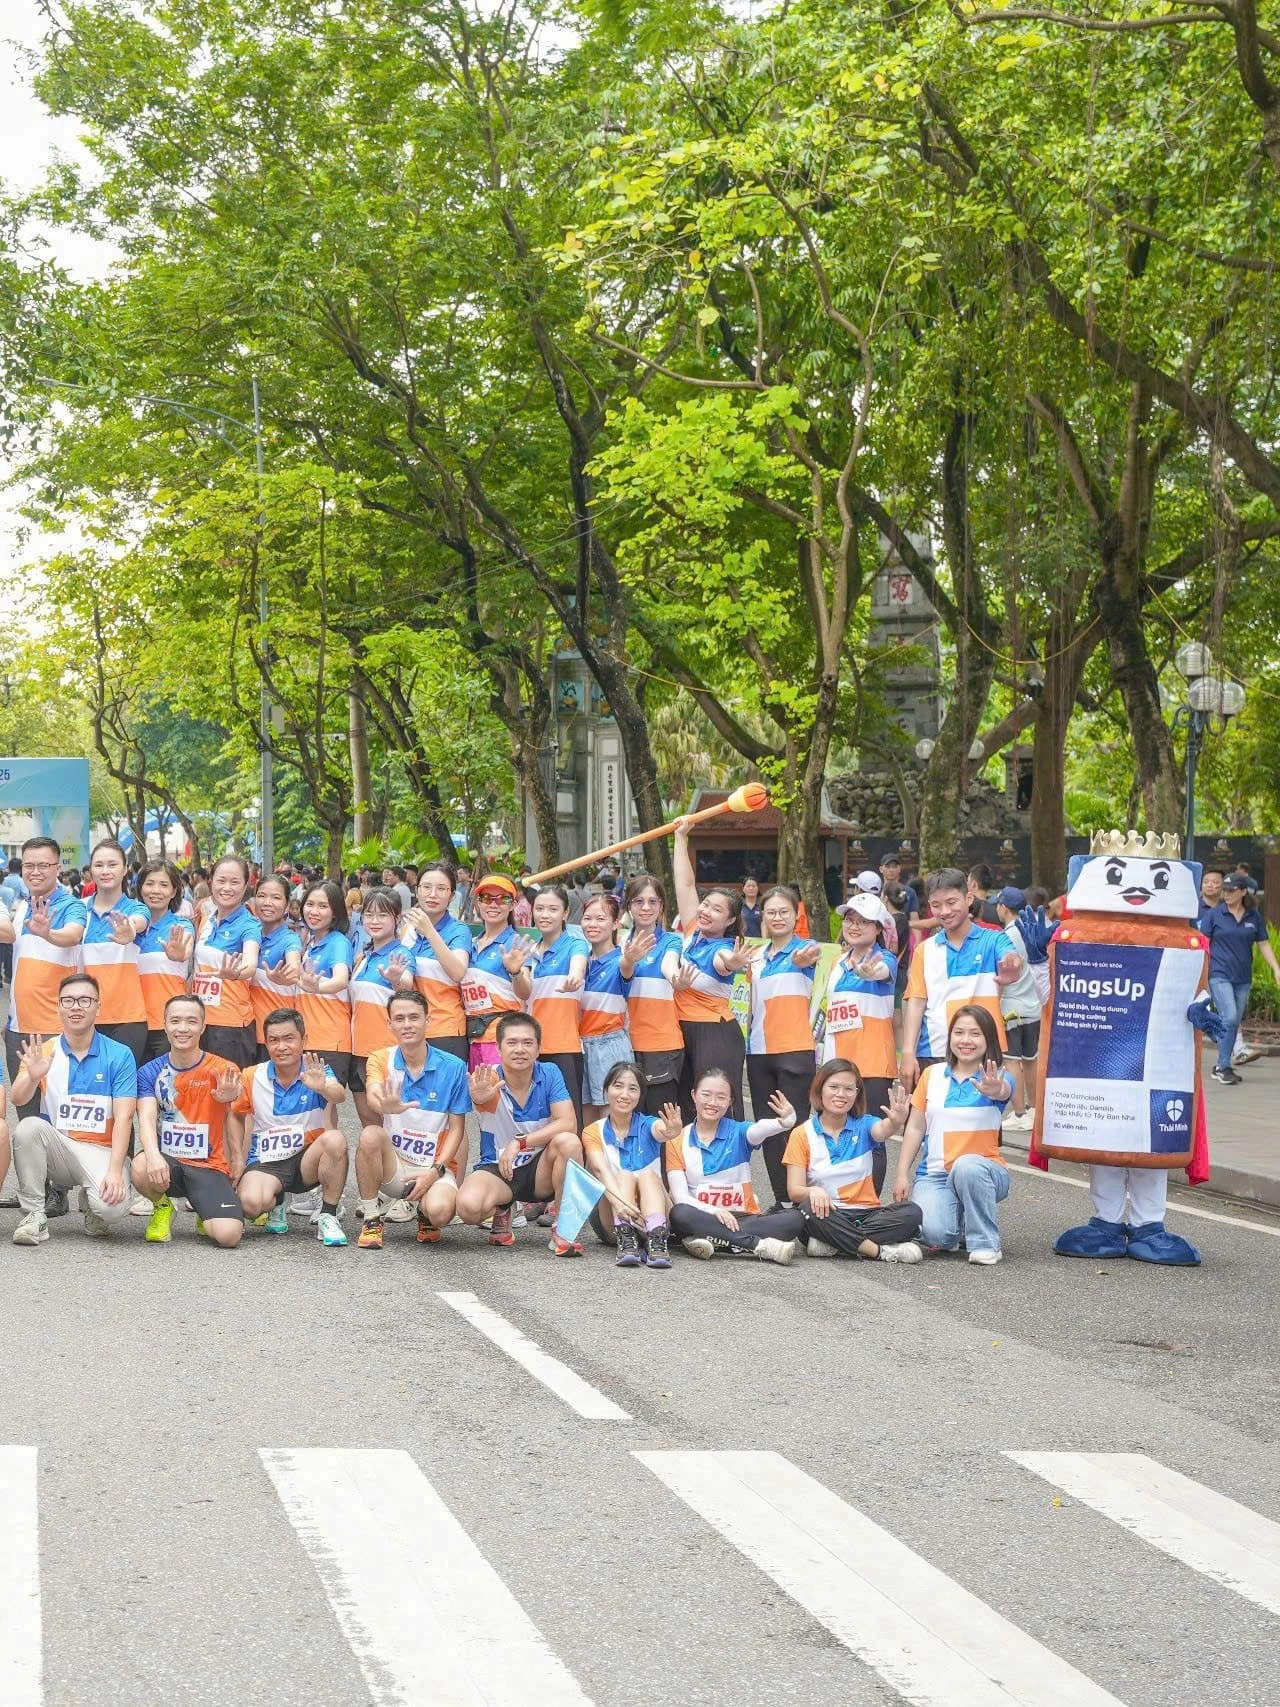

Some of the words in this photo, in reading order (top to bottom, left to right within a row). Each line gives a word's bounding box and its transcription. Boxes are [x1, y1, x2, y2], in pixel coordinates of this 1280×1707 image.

[1060, 973, 1145, 1001] KingsUp
[827, 1004, 859, 1023] 9785
[59, 1104, 104, 1121] 9778
[163, 1131, 204, 1147] 9791
[261, 1133, 303, 1152] 9792
[391, 1134, 435, 1157] 9782
[698, 1192, 743, 1207] 9784
